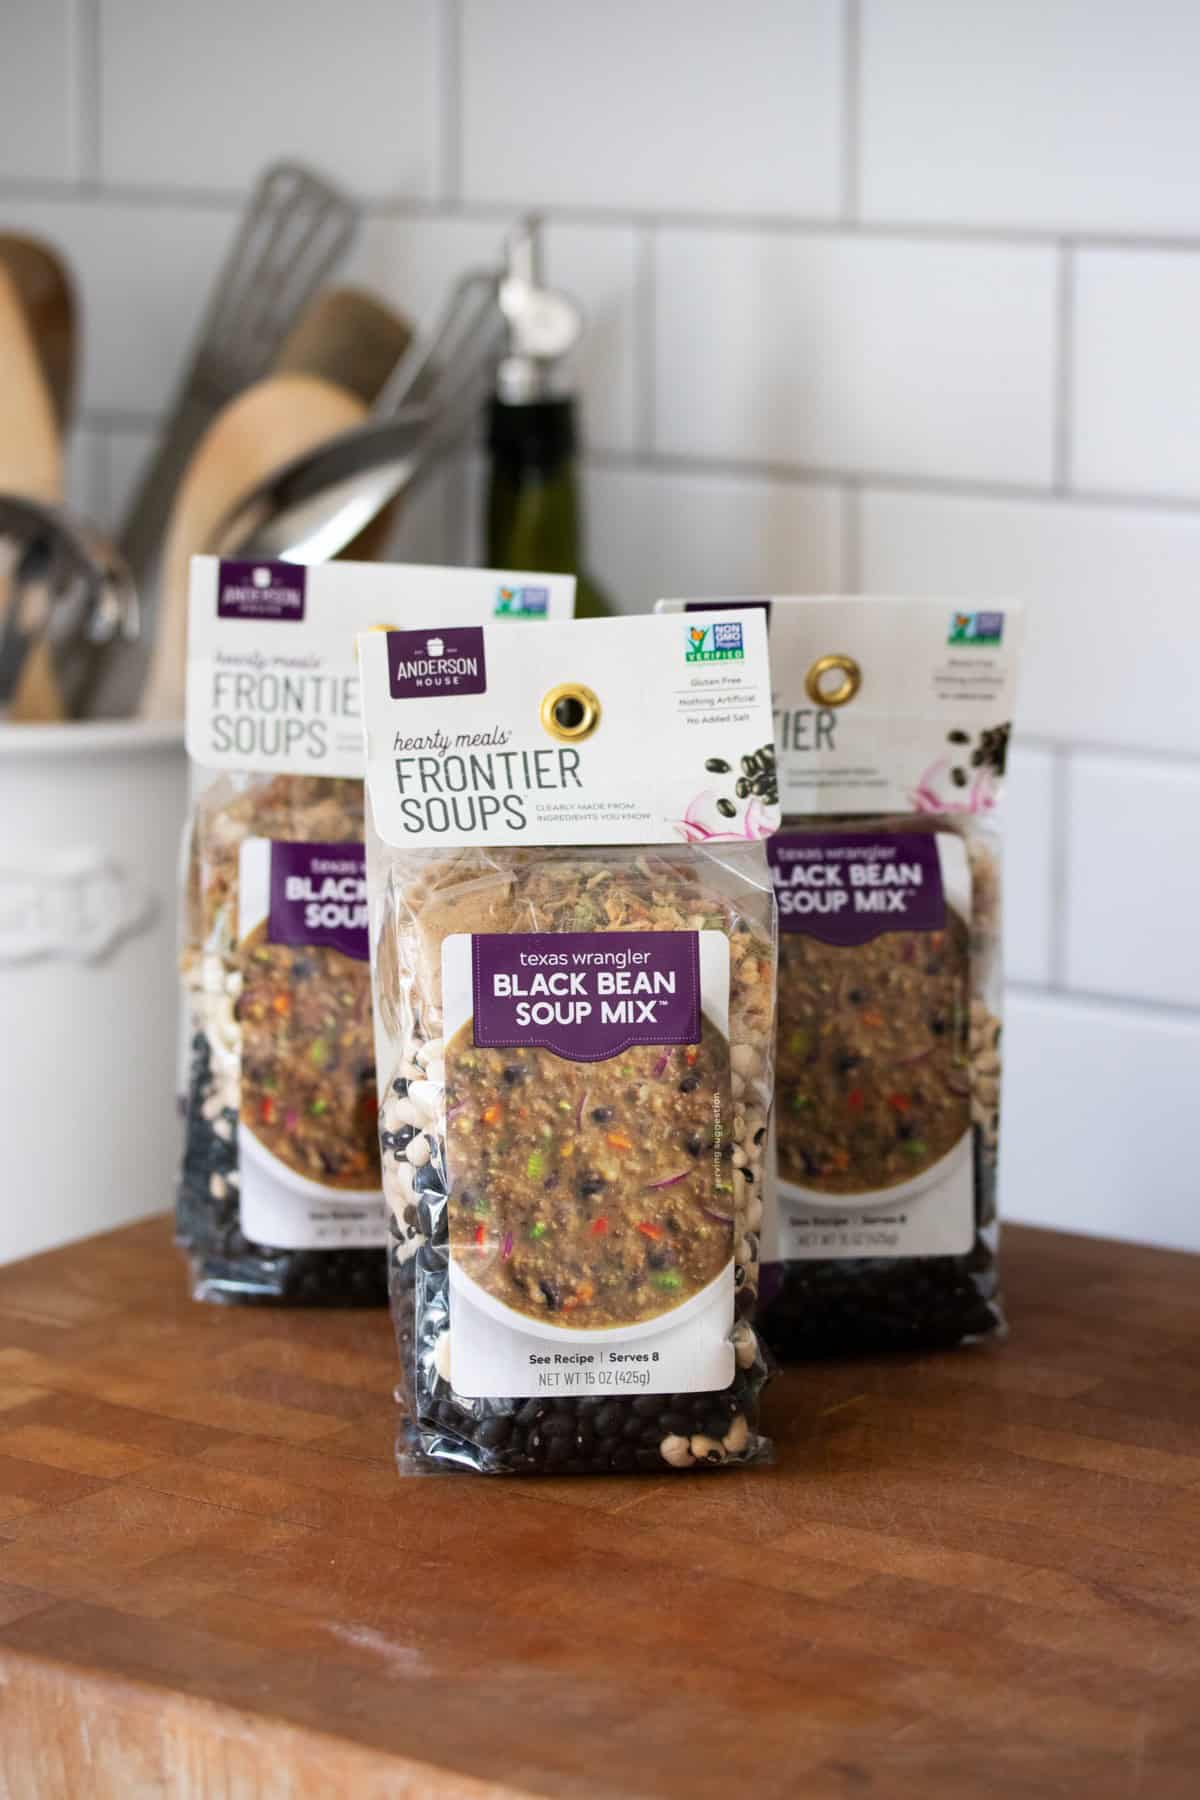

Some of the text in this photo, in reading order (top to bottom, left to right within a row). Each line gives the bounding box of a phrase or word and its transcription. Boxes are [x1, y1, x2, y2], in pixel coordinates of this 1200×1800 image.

[715, 624, 741, 633] NON
[688, 650, 743, 661] VERIFIED
[397, 657, 478, 681] ANDERSON
[721, 676, 742, 685] Free
[415, 676, 460, 687] HOUSE
[212, 672, 361, 717] FRONTIE
[733, 712, 750, 721] Salt
[211, 714, 328, 759] SOUPS
[393, 729, 453, 758] hearty
[395, 747, 584, 795] FRONTIER
[399, 793, 528, 834] SOUPS
[849, 862, 923, 887] BEAN
[778, 888, 848, 914] SOUP
[519, 949, 652, 968] texas wrangler
[493, 970, 676, 998] BLACK BEAN
[515, 1002, 592, 1026] SOUP
[529, 1351, 660, 1367] See Recipe Serves 8
[538, 1370, 651, 1387] NET WT 15 OZ (425g)
